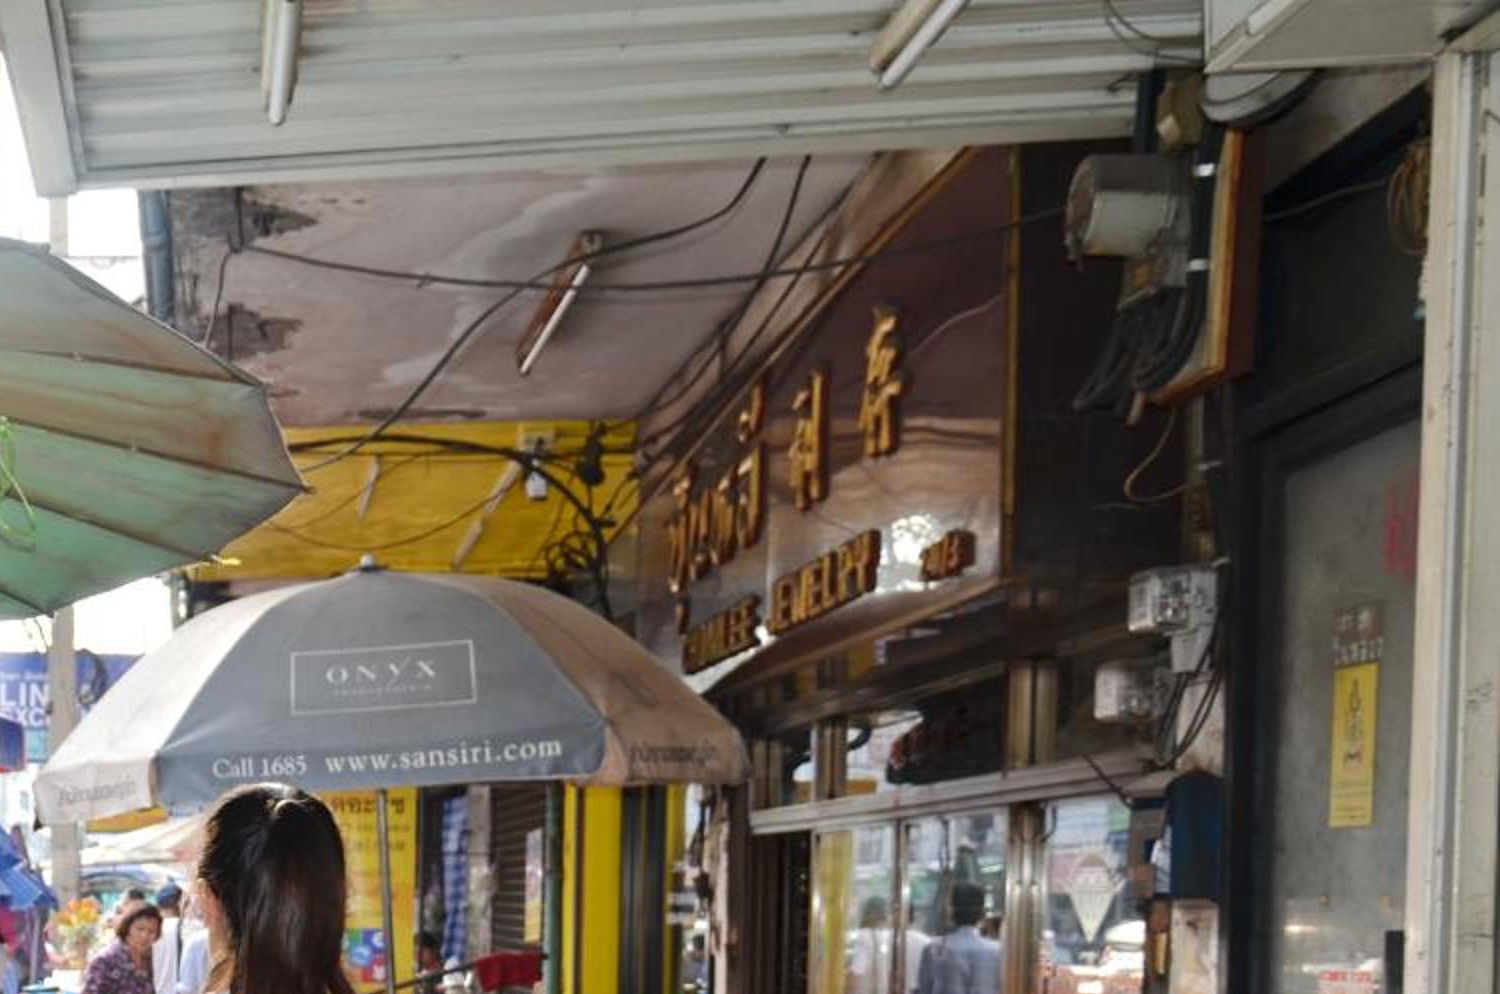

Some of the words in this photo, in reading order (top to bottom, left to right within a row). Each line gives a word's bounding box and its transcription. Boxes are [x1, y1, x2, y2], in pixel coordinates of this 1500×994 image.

[212, 757, 255, 779] Call
[260, 755, 307, 777] 1685
[324, 738, 563, 774] www.sansiri.com
